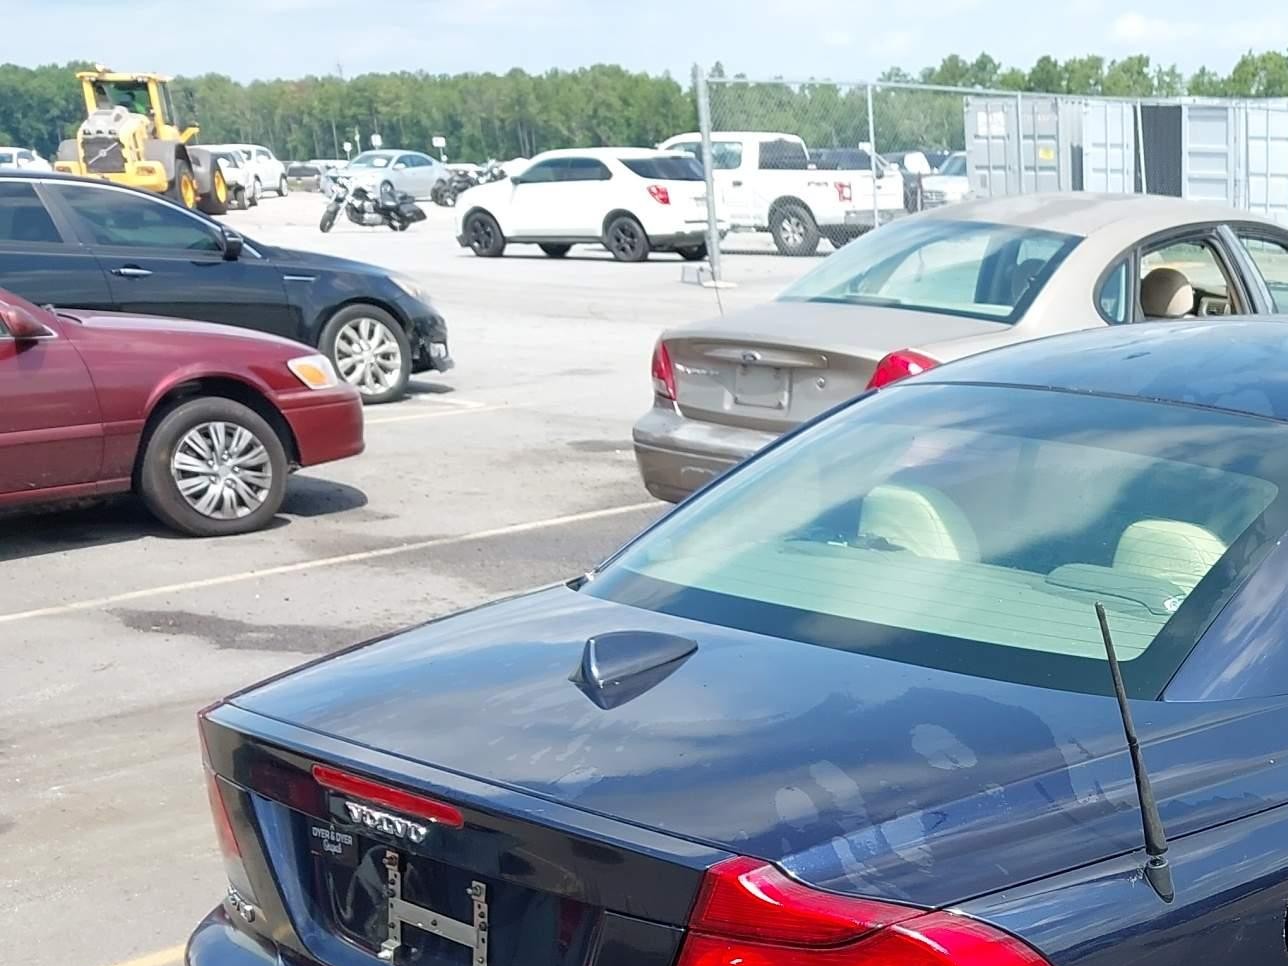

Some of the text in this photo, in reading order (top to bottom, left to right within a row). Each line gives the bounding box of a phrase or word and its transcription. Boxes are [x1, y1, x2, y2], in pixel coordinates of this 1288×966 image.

[312, 827, 330, 840] DYER
[335, 832, 353, 846] DYER
[345, 801, 427, 843] VOLVO
